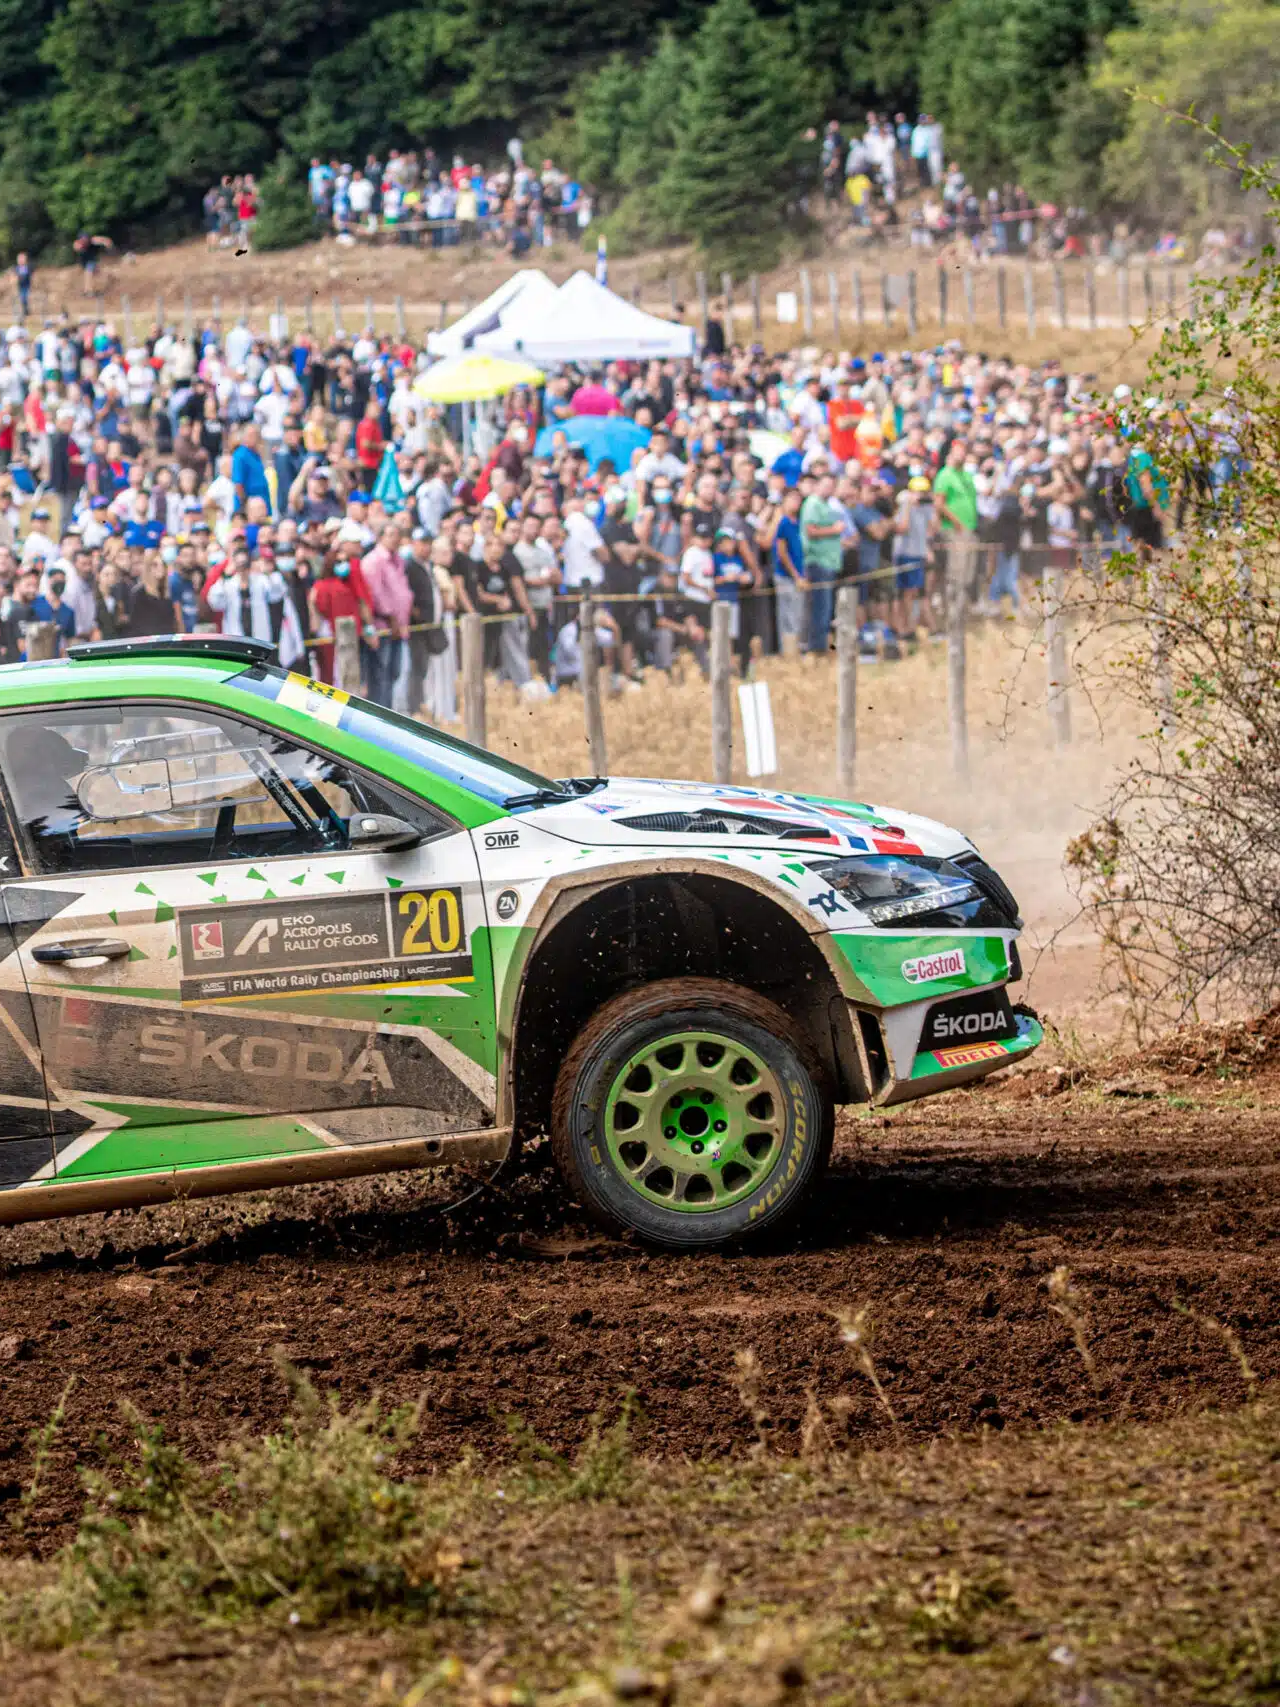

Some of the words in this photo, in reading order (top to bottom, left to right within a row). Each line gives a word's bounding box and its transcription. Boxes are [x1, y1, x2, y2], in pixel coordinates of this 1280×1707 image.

[485, 833, 519, 847] OMP
[282, 915, 315, 926] EKO
[283, 923, 352, 939] ACROPOLIS
[398, 889, 462, 955] 20
[284, 938, 320, 952] RALLY
[323, 937, 340, 948] OF
[343, 934, 379, 946] GODS
[918, 952, 963, 979] Castrol
[233, 980, 252, 991] FIA
[255, 976, 287, 989] World
[291, 973, 319, 986] Rally
[322, 967, 400, 983] Championship
[933, 1010, 1008, 1038] ŠKODA
[139, 1016, 396, 1090] ŠKODA
